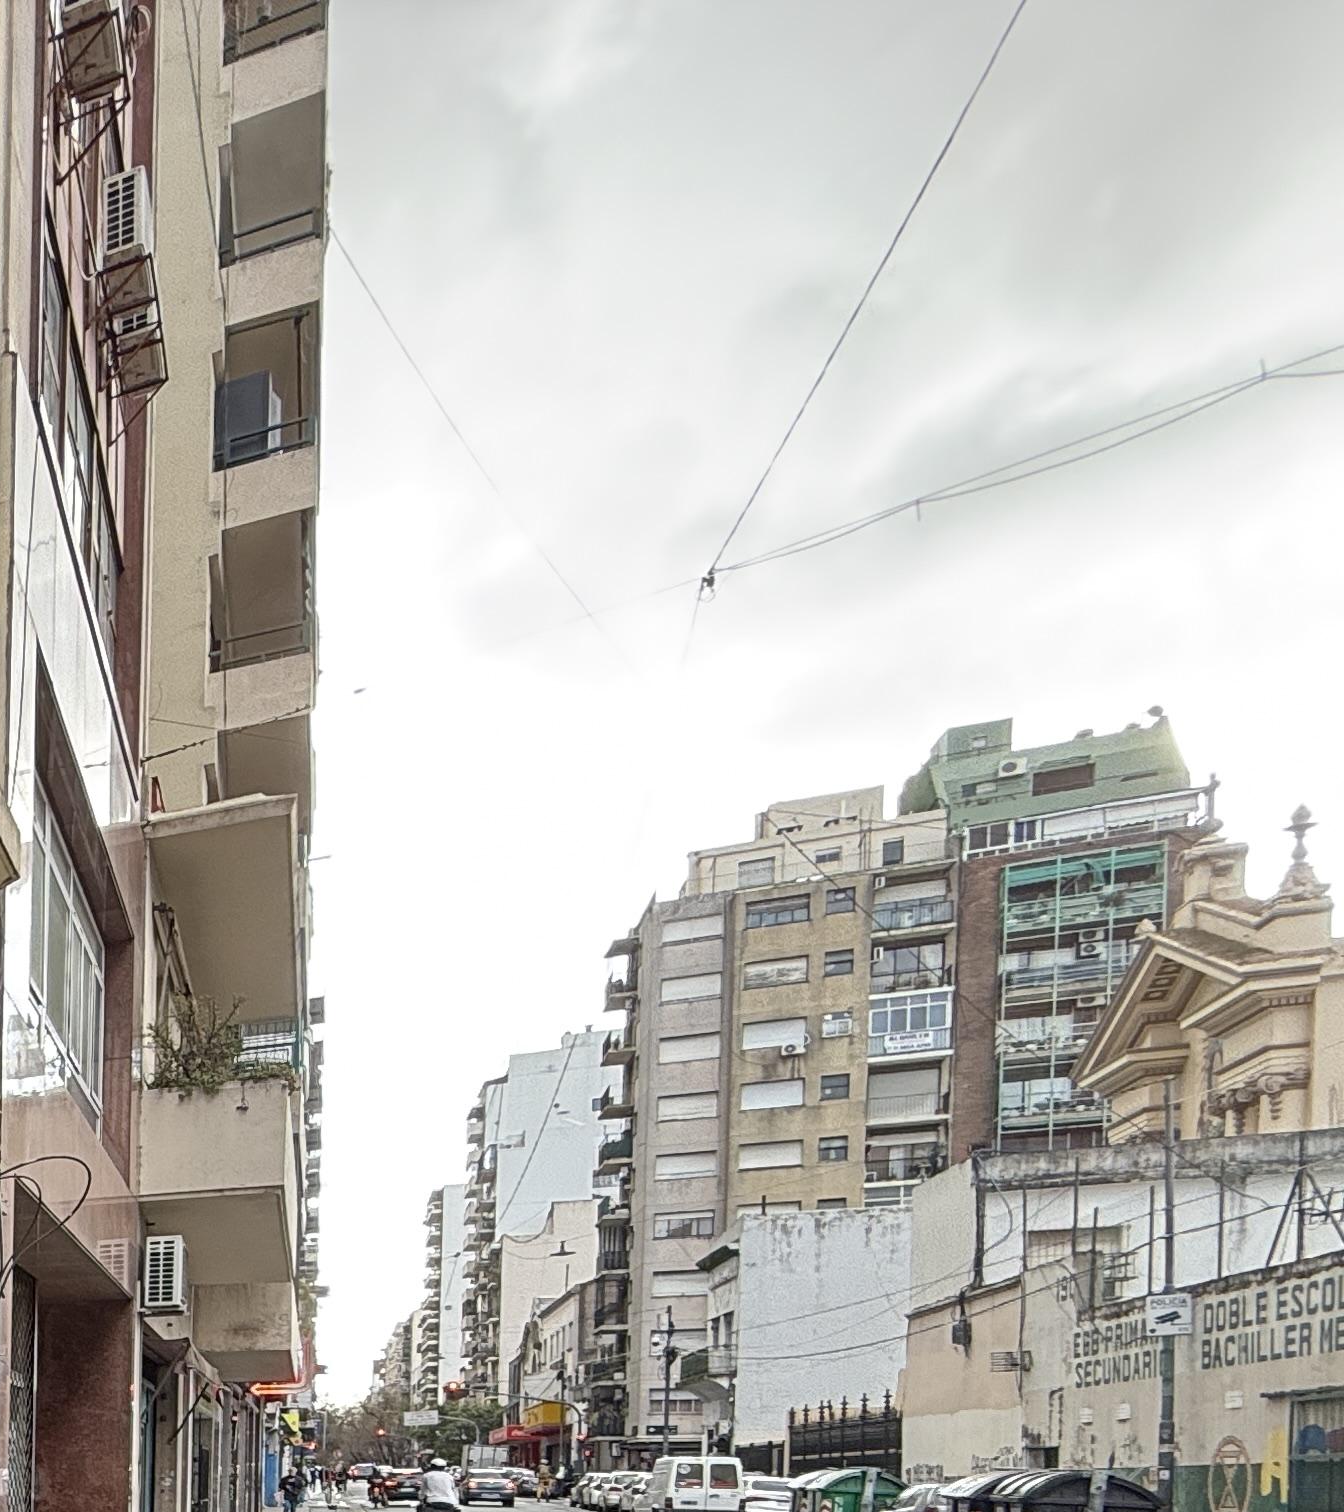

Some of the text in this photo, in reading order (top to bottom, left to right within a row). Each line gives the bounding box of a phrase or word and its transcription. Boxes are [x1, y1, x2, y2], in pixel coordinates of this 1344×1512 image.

[1204, 1291, 1268, 1334] DOBLE
[1074, 1329, 1100, 1358] EGB
[1202, 1322, 1312, 1370] BACHILLER
[1075, 1348, 1164, 1388] SECUNDARI
